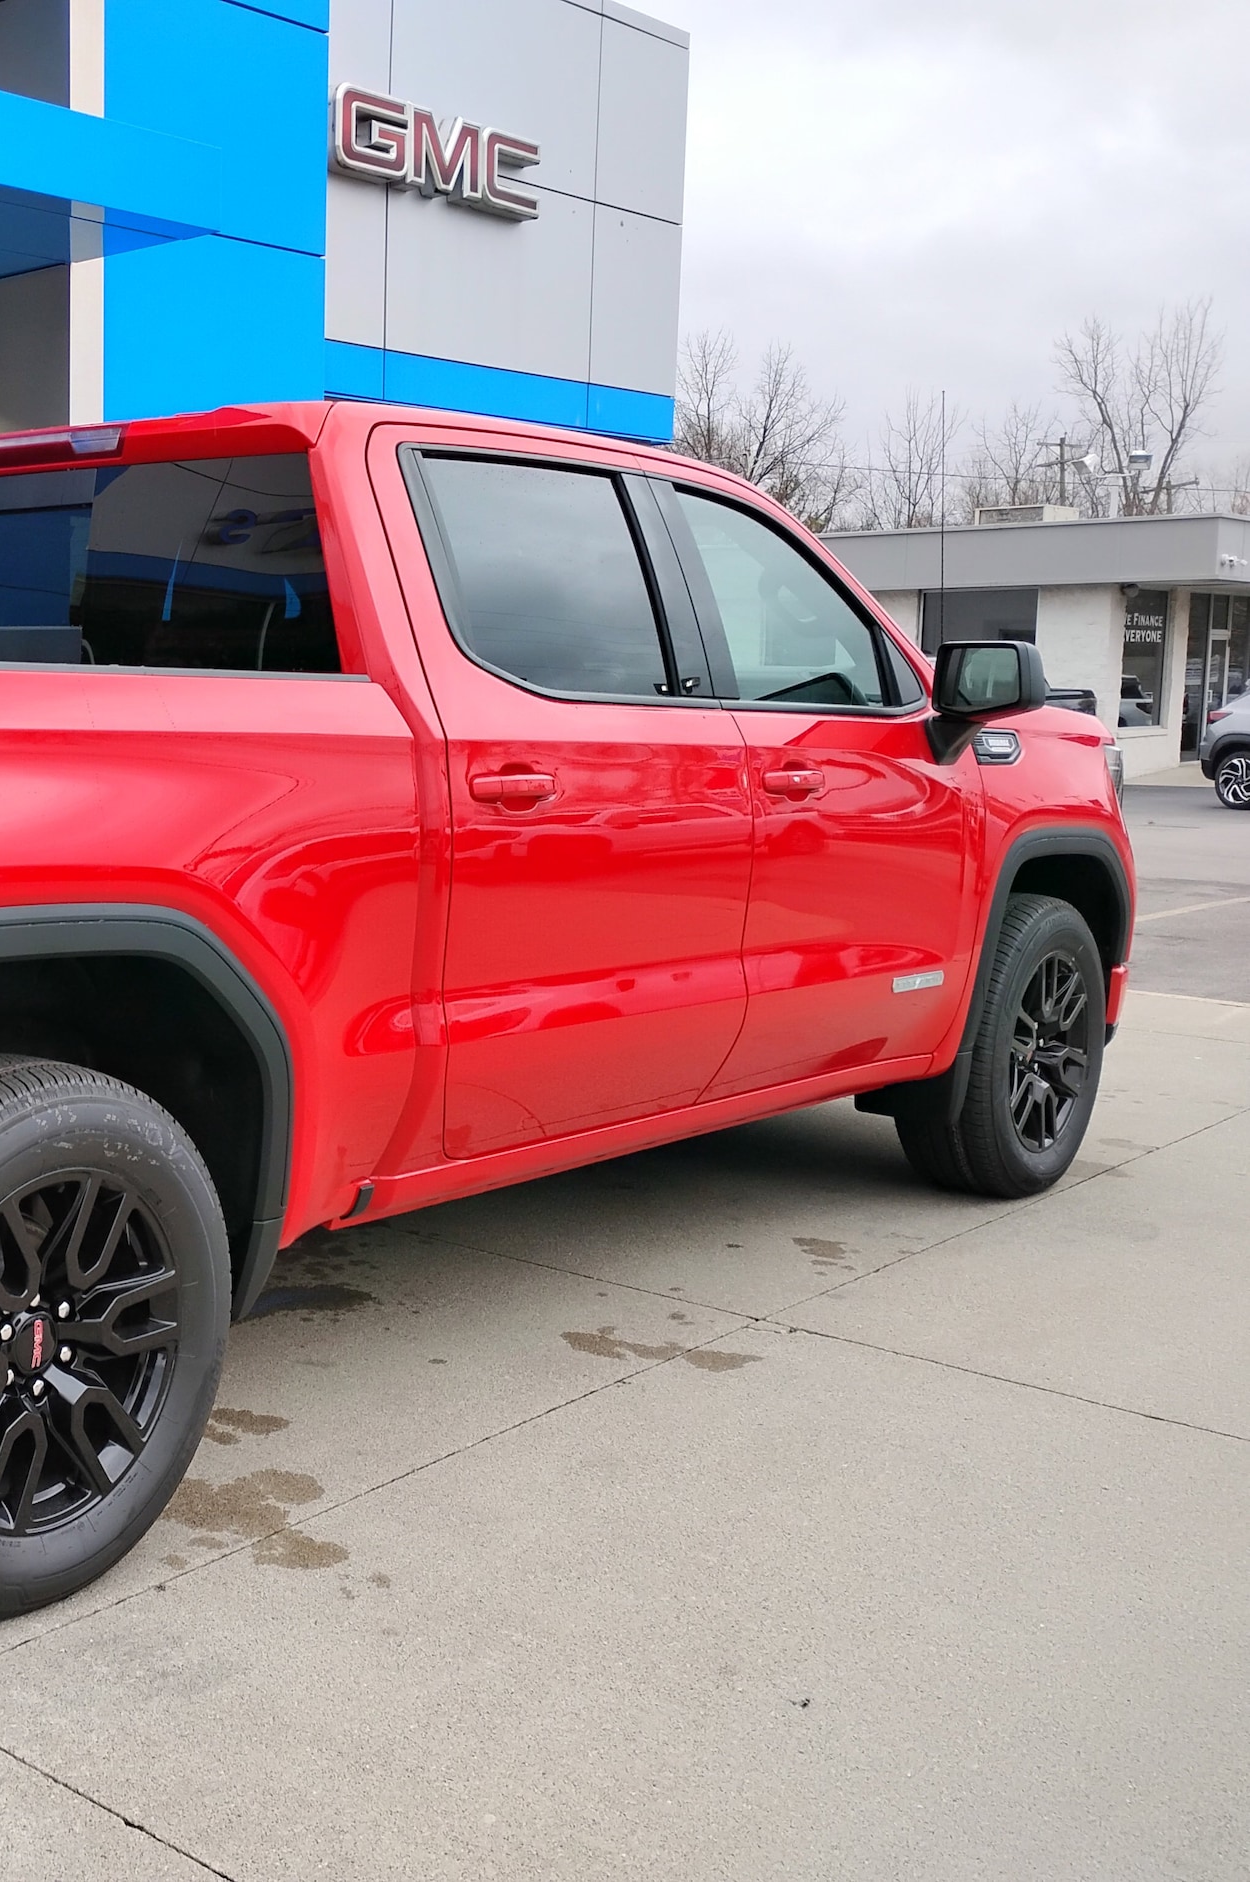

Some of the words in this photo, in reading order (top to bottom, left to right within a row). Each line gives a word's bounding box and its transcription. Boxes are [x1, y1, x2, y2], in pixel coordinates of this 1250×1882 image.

[334, 82, 541, 221] GMC
[1133, 612, 1164, 627] FINANCE
[31, 1318, 44, 1370] GMC
